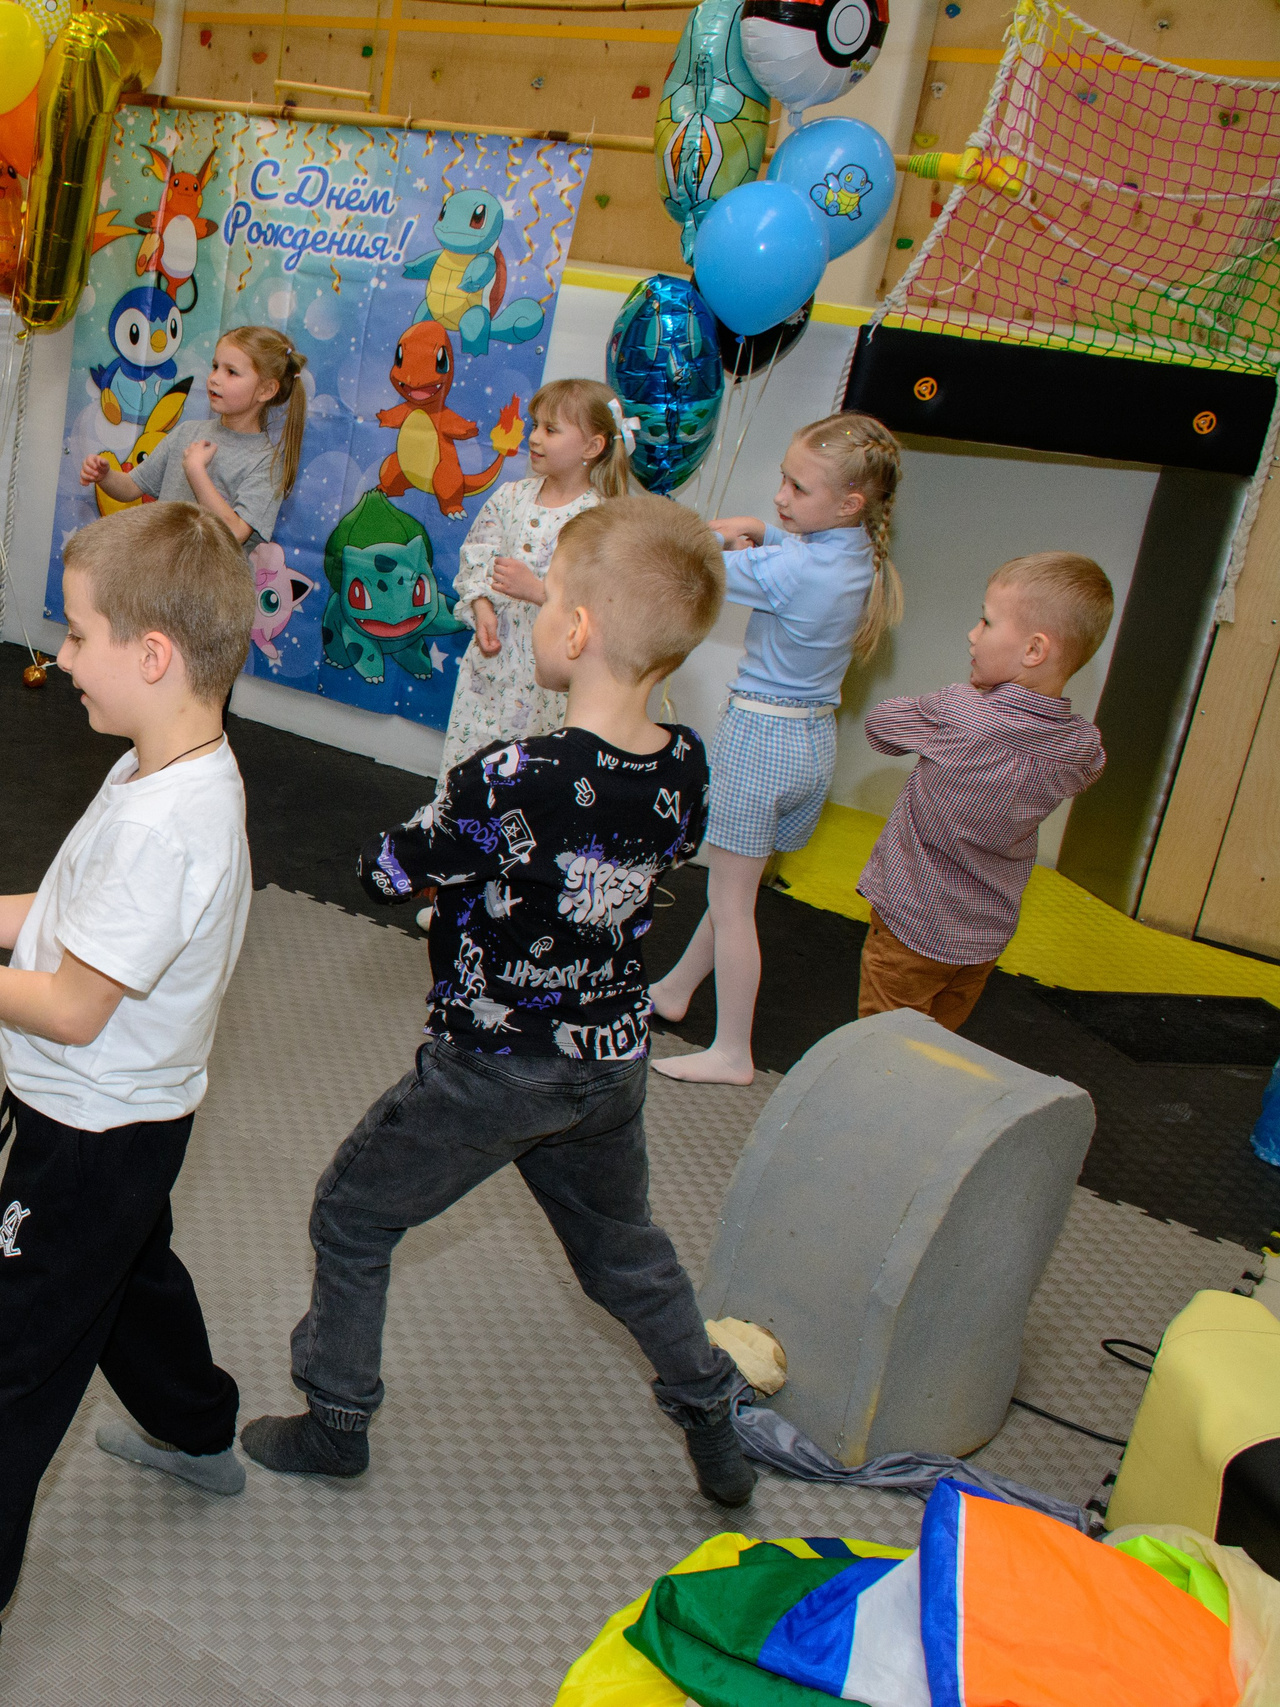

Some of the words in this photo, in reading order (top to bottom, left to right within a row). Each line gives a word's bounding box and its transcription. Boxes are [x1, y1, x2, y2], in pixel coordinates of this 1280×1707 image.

[250, 159, 281, 201] С
[283, 165, 395, 215] Днём
[223, 200, 415, 271] Рождения!
